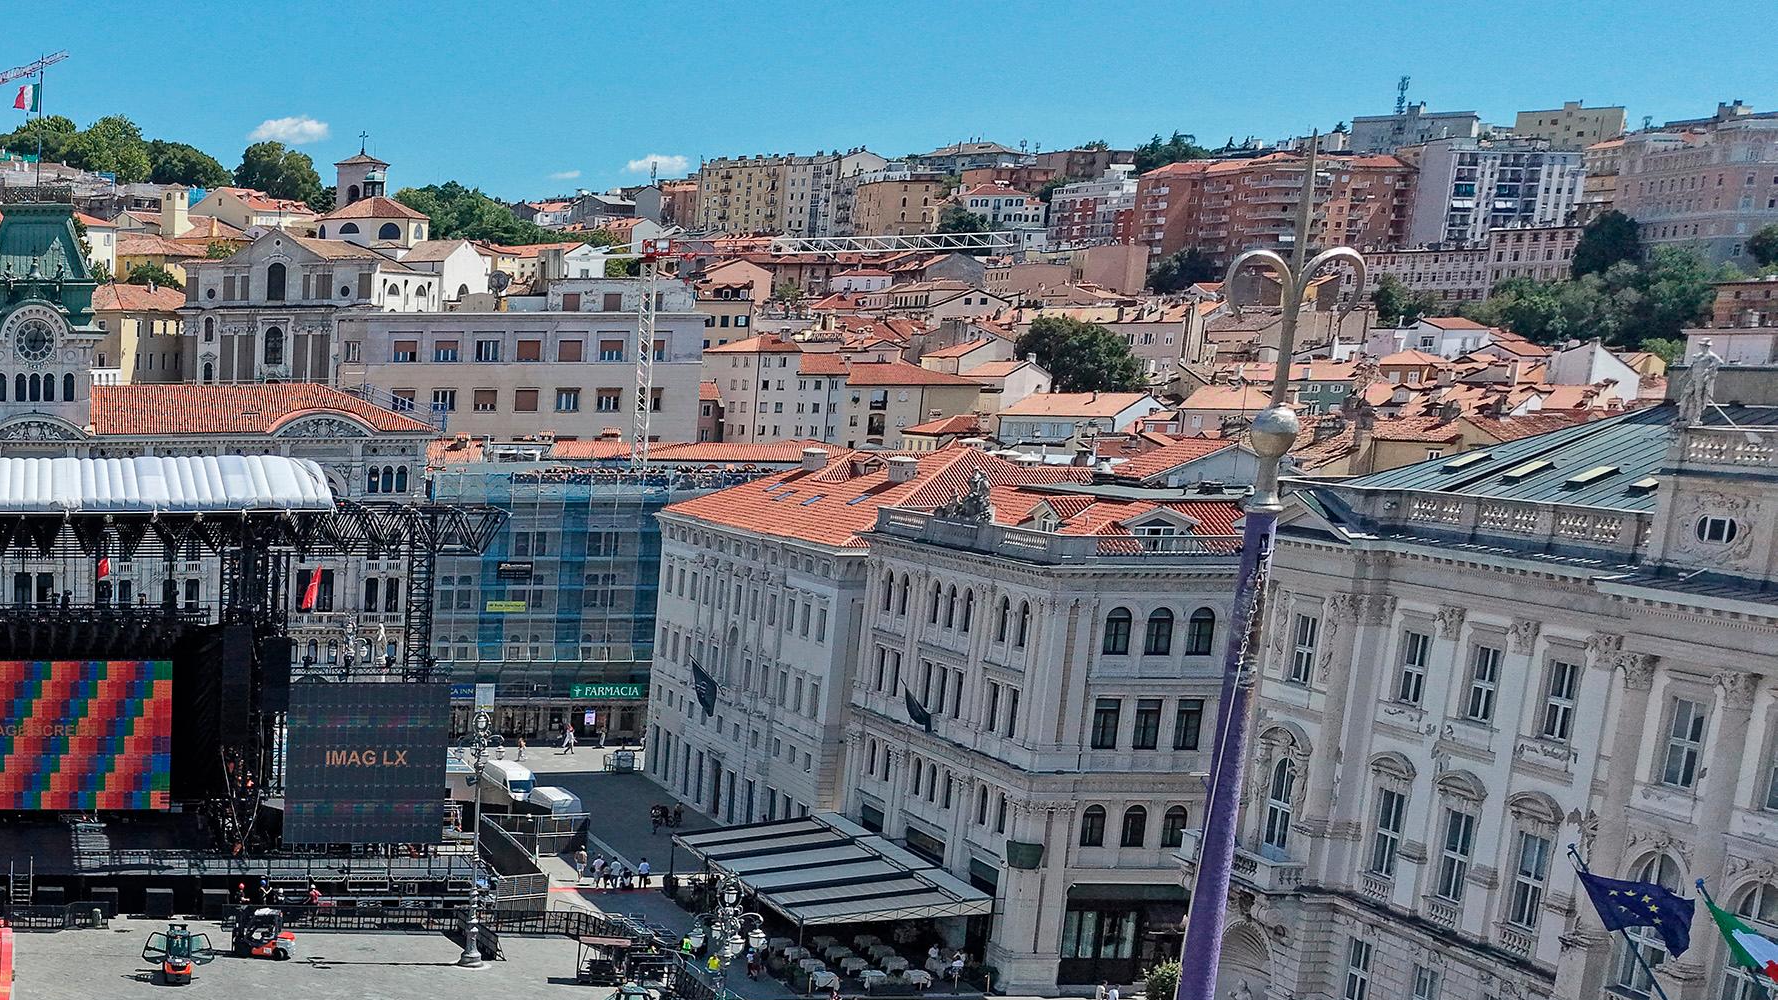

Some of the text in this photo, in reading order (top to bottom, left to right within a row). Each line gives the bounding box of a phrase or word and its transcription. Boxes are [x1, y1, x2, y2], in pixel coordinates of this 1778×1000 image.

[584, 686, 639, 696] FARMACIA
[325, 750, 408, 766] IMAG LX
